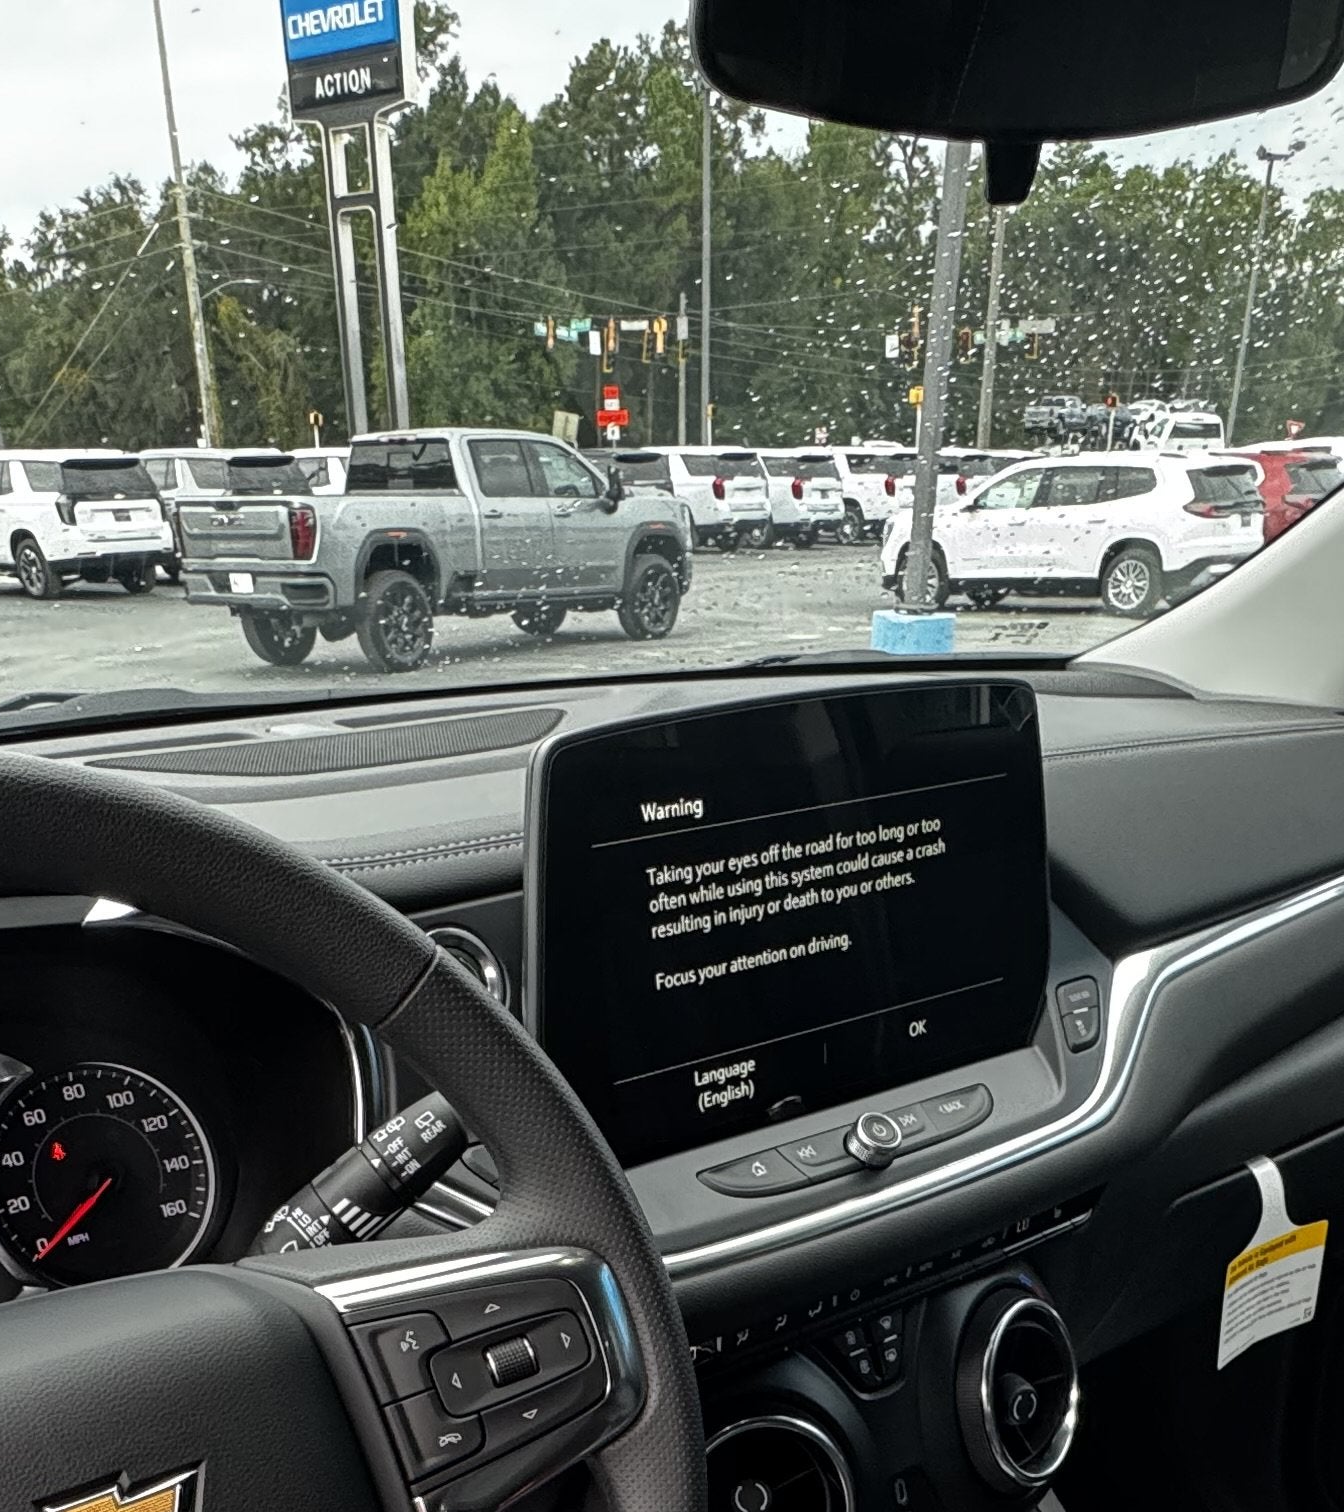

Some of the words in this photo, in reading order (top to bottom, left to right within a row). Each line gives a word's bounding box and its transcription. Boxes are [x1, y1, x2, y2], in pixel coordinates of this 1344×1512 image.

[287, 0, 385, 40] CHEVROLET
[315, 67, 372, 99] ACTION
[640, 797, 704, 823] Warning
[646, 865, 693, 886] Taking
[695, 860, 726, 879] your
[727, 853, 759, 875] eyes
[760, 844, 780, 865] off
[782, 841, 803, 861] the
[805, 834, 834, 856] road
[836, 831, 854, 852] for
[855, 828, 877, 847] too
[879, 824, 905, 845] long
[906, 822, 920, 837] or
[921, 818, 941, 834] too
[649, 894, 687, 914] often
[689, 883, 725, 905] while
[727, 876, 763, 899] using
[764, 871, 789, 891] this
[791, 863, 835, 886] system
[836, 853, 869, 876] could
[871, 851, 905, 869] cause
[905, 849, 914, 862] a
[915, 838, 947, 858] crash
[651, 912, 712, 940] resulting
[713, 907, 727, 926] in
[729, 901, 765, 926] injury
[767, 900, 782, 915] or
[783, 889, 819, 911] death
[821, 887, 835, 902] to
[836, 883, 858, 900] you
[859, 879, 873, 894] or
[875, 871, 916, 891] others.
[656, 970, 696, 991] Focus
[698, 962, 728, 985] your
[729, 947, 788, 973] attention
[789, 945, 806, 959] on
[808, 932, 853, 955] driving.
[909, 1019, 927, 1038] OK
[694, 1059, 756, 1087] Language
[62, 1083, 86, 1101] 80
[106, 1090, 135, 1109] 100
[697, 1079, 755, 1113] (English)
[22, 1108, 47, 1127] 60
[141, 1116, 168, 1134] 120
[420, 1119, 447, 1143] REAR
[1, 1151, 25, 1168] 40
[163, 1155, 190, 1173] 140
[6, 1196, 30, 1214] 20
[160, 1199, 187, 1218] 160
[298, 1213, 312, 1228] LO
[306, 1219, 322, 1237] INT
[67, 1232, 90, 1247] MPH
[313, 1227, 331, 1246] OFF
